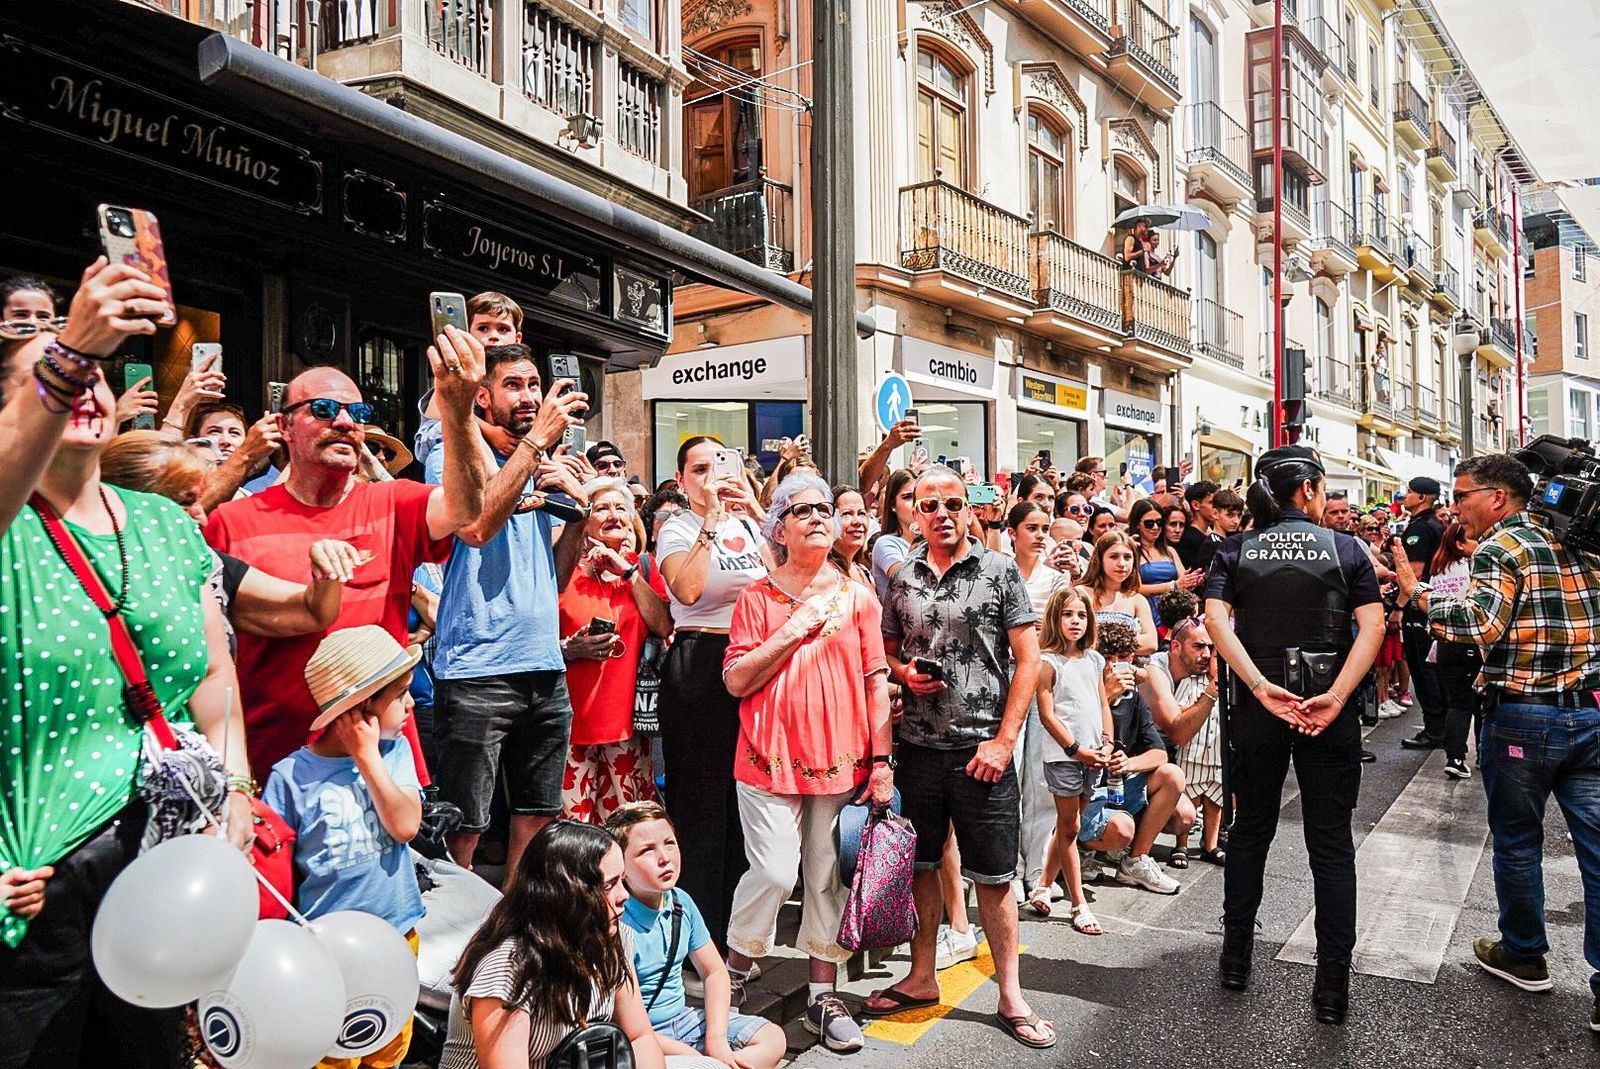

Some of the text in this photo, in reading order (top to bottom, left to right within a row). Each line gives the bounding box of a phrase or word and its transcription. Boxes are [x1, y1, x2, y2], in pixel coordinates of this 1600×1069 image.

[48, 75, 281, 186] Miguel Muñoz
[462, 226, 536, 270] Joyeros
[672, 357, 767, 384] exchange
[929, 358, 977, 384] cambio
[1025, 378, 1046, 391] Western
[1116, 404, 1156, 426] exchange
[1258, 532, 1317, 542] POLICIA
[716, 551, 764, 571] MEN
[1245, 549, 1331, 560] GRANADA
